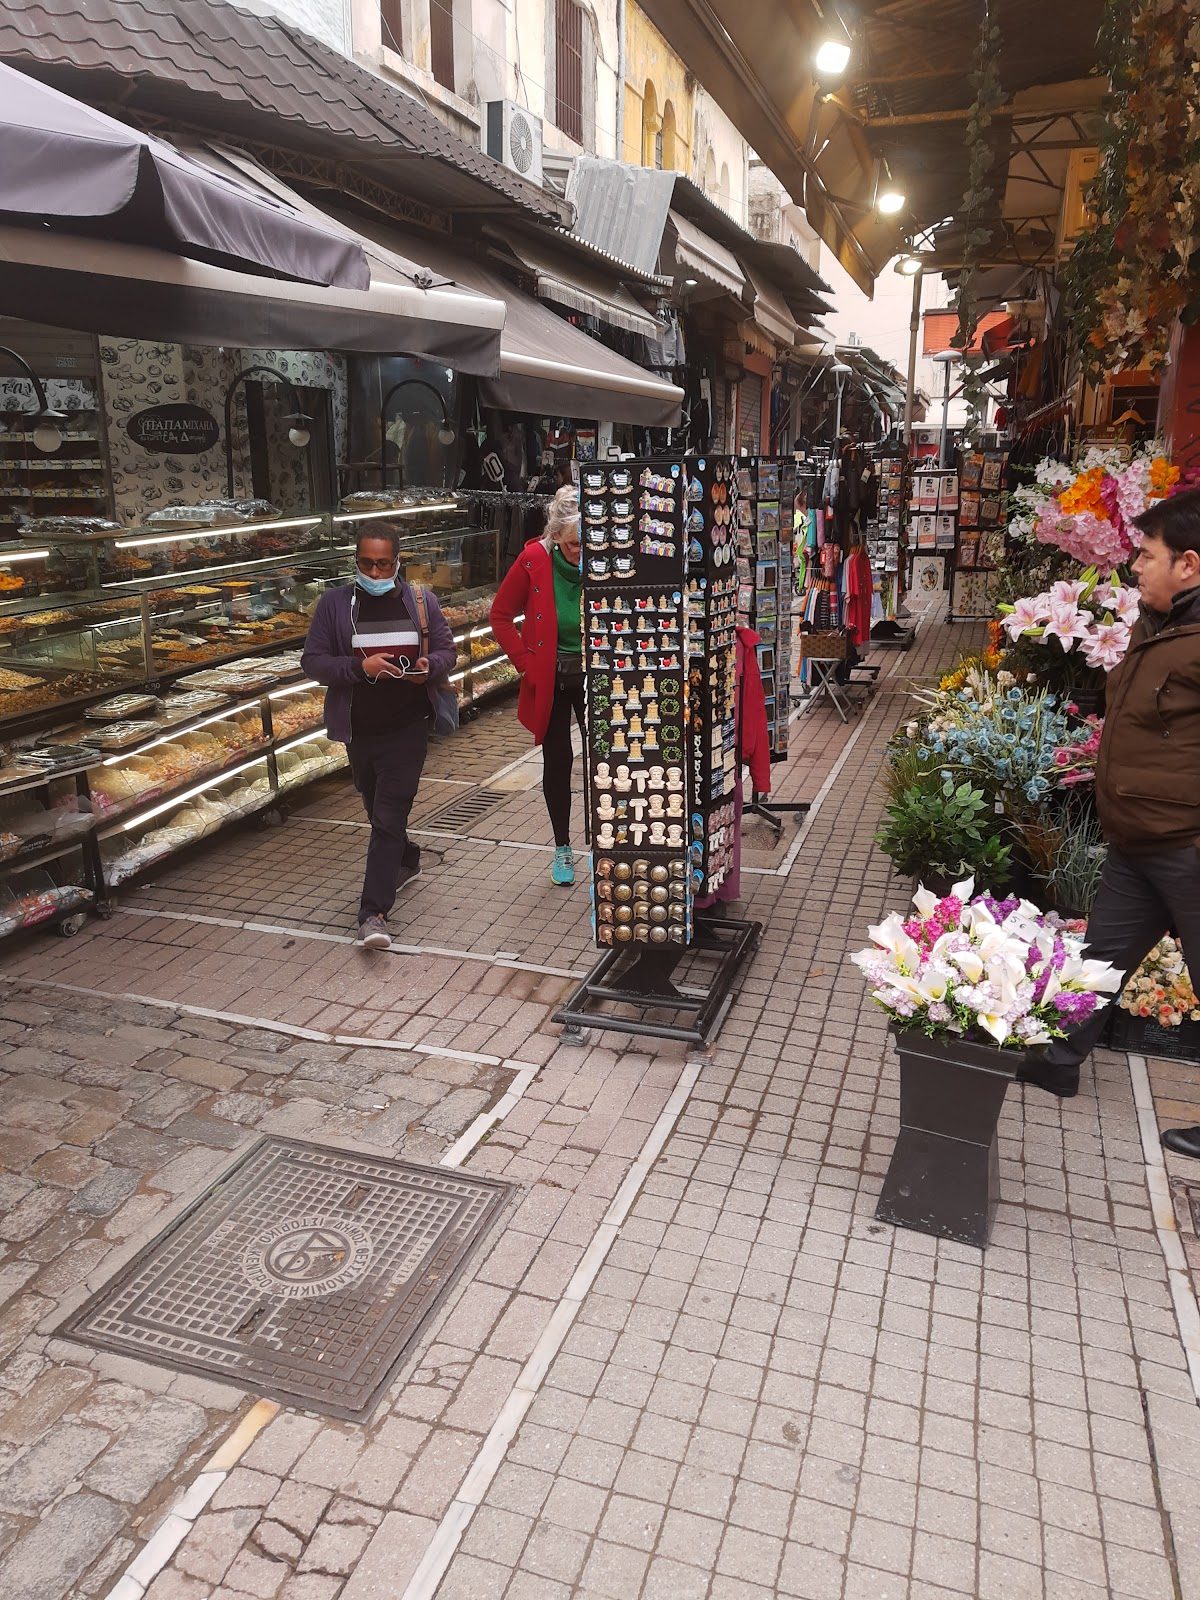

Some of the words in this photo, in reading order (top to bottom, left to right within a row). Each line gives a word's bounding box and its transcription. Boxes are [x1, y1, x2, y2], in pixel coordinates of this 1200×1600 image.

[485, 457, 502, 482] 10
[258, 1217, 325, 1244] ΙΣΤΟΡΙΚΟ
[333, 1220, 368, 1246] ΔΗΜΟΣ
[245, 1246, 273, 1288] ΚΕΝΤΡΟ
[280, 1247, 370, 1297] ΘΕΣΣΑΛΟΝΙΚΗΣ
